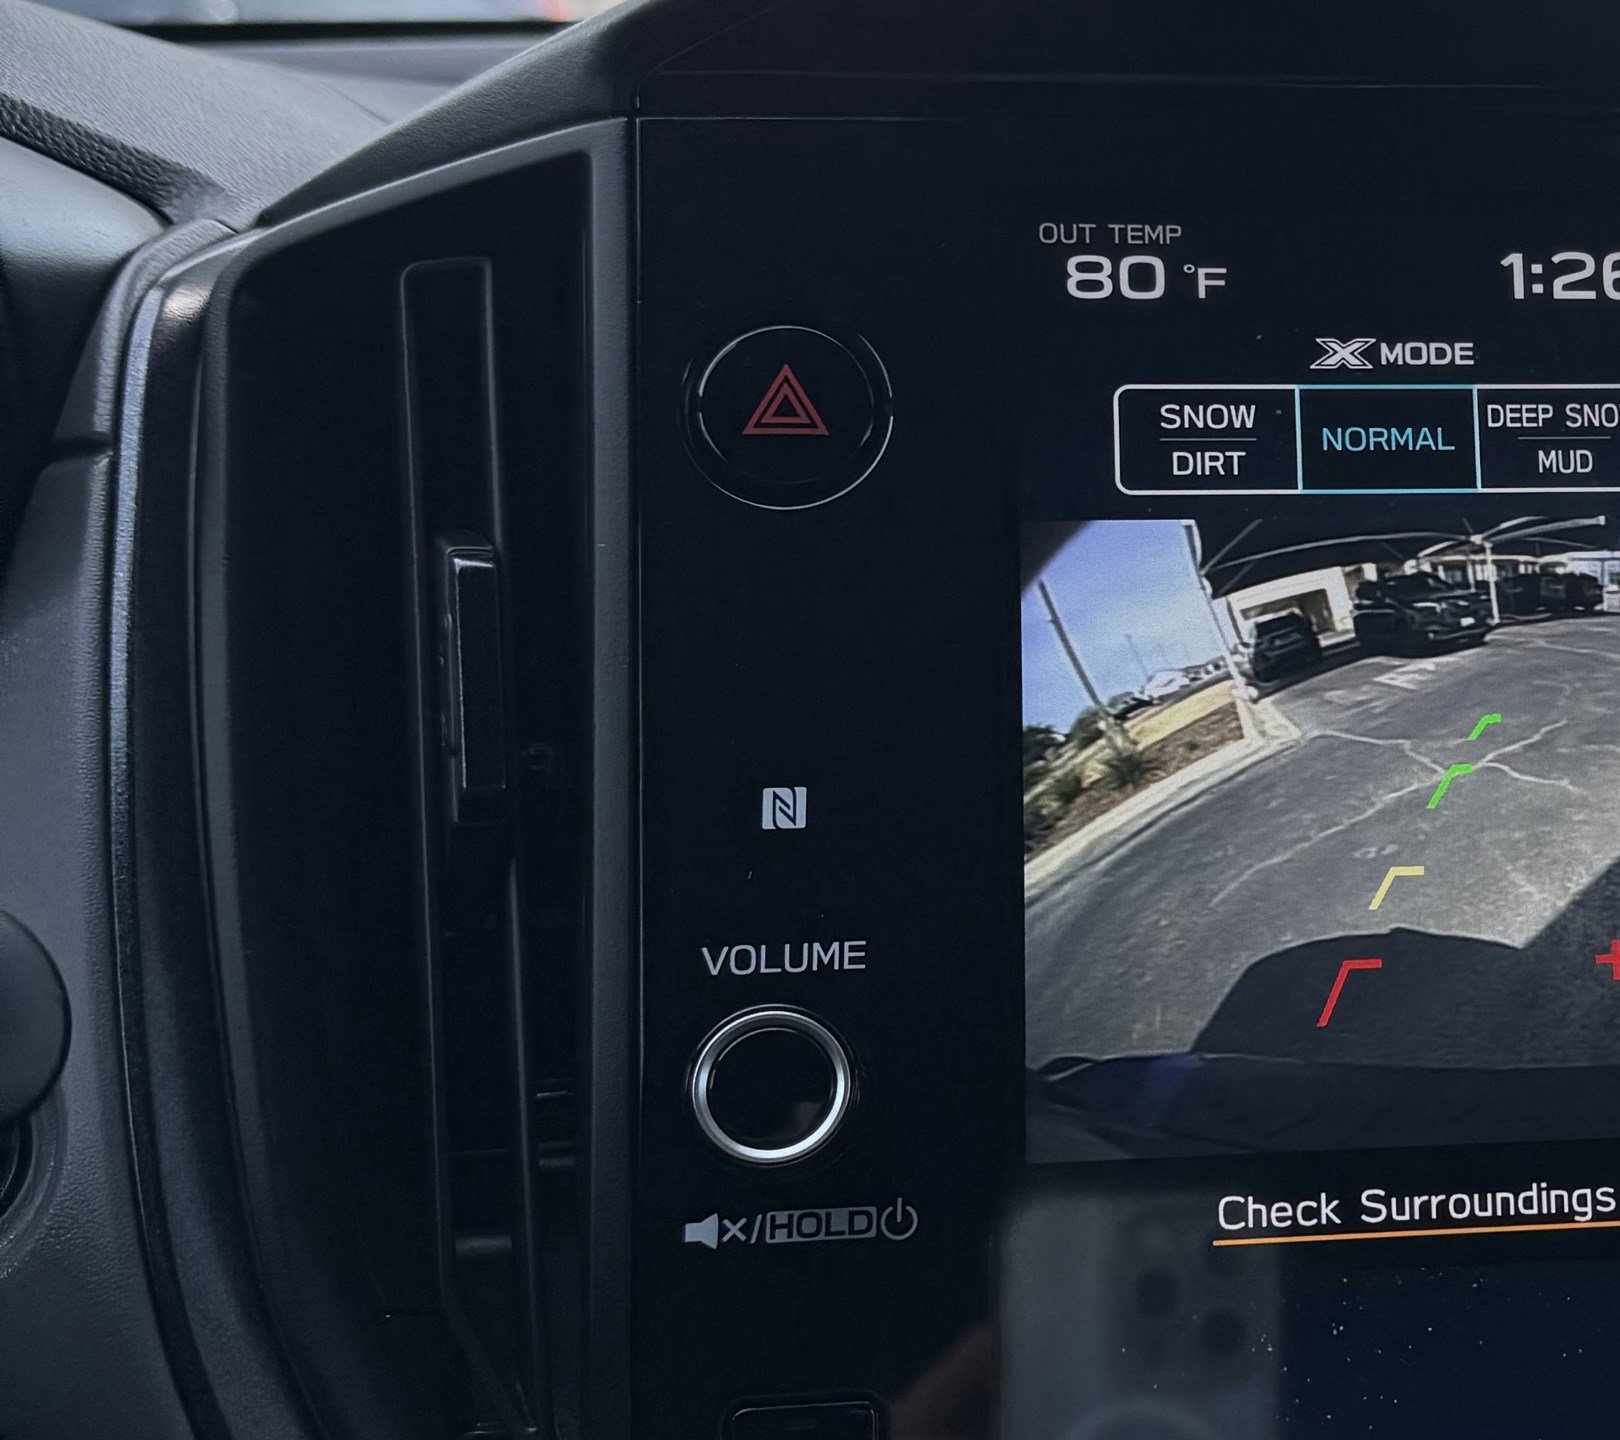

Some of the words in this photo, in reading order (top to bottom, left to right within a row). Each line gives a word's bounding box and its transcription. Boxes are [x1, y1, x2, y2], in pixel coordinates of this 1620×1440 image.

[1038, 223, 1095, 245] OUT
[1108, 223, 1182, 246] TEMP
[1065, 254, 1166, 301] 80
[1380, 342, 1475, 366] MODE
[1159, 404, 1257, 429] SNOW
[1487, 404, 1554, 428] DEEP
[1322, 427, 1456, 452] NORMAL
[1171, 450, 1246, 477] DIRT
[1537, 449, 1594, 475] MUD
[701, 940, 868, 976] VOLUME
[1217, 1194, 1343, 1232] Check
[1360, 1181, 1617, 1223] Surroundings
